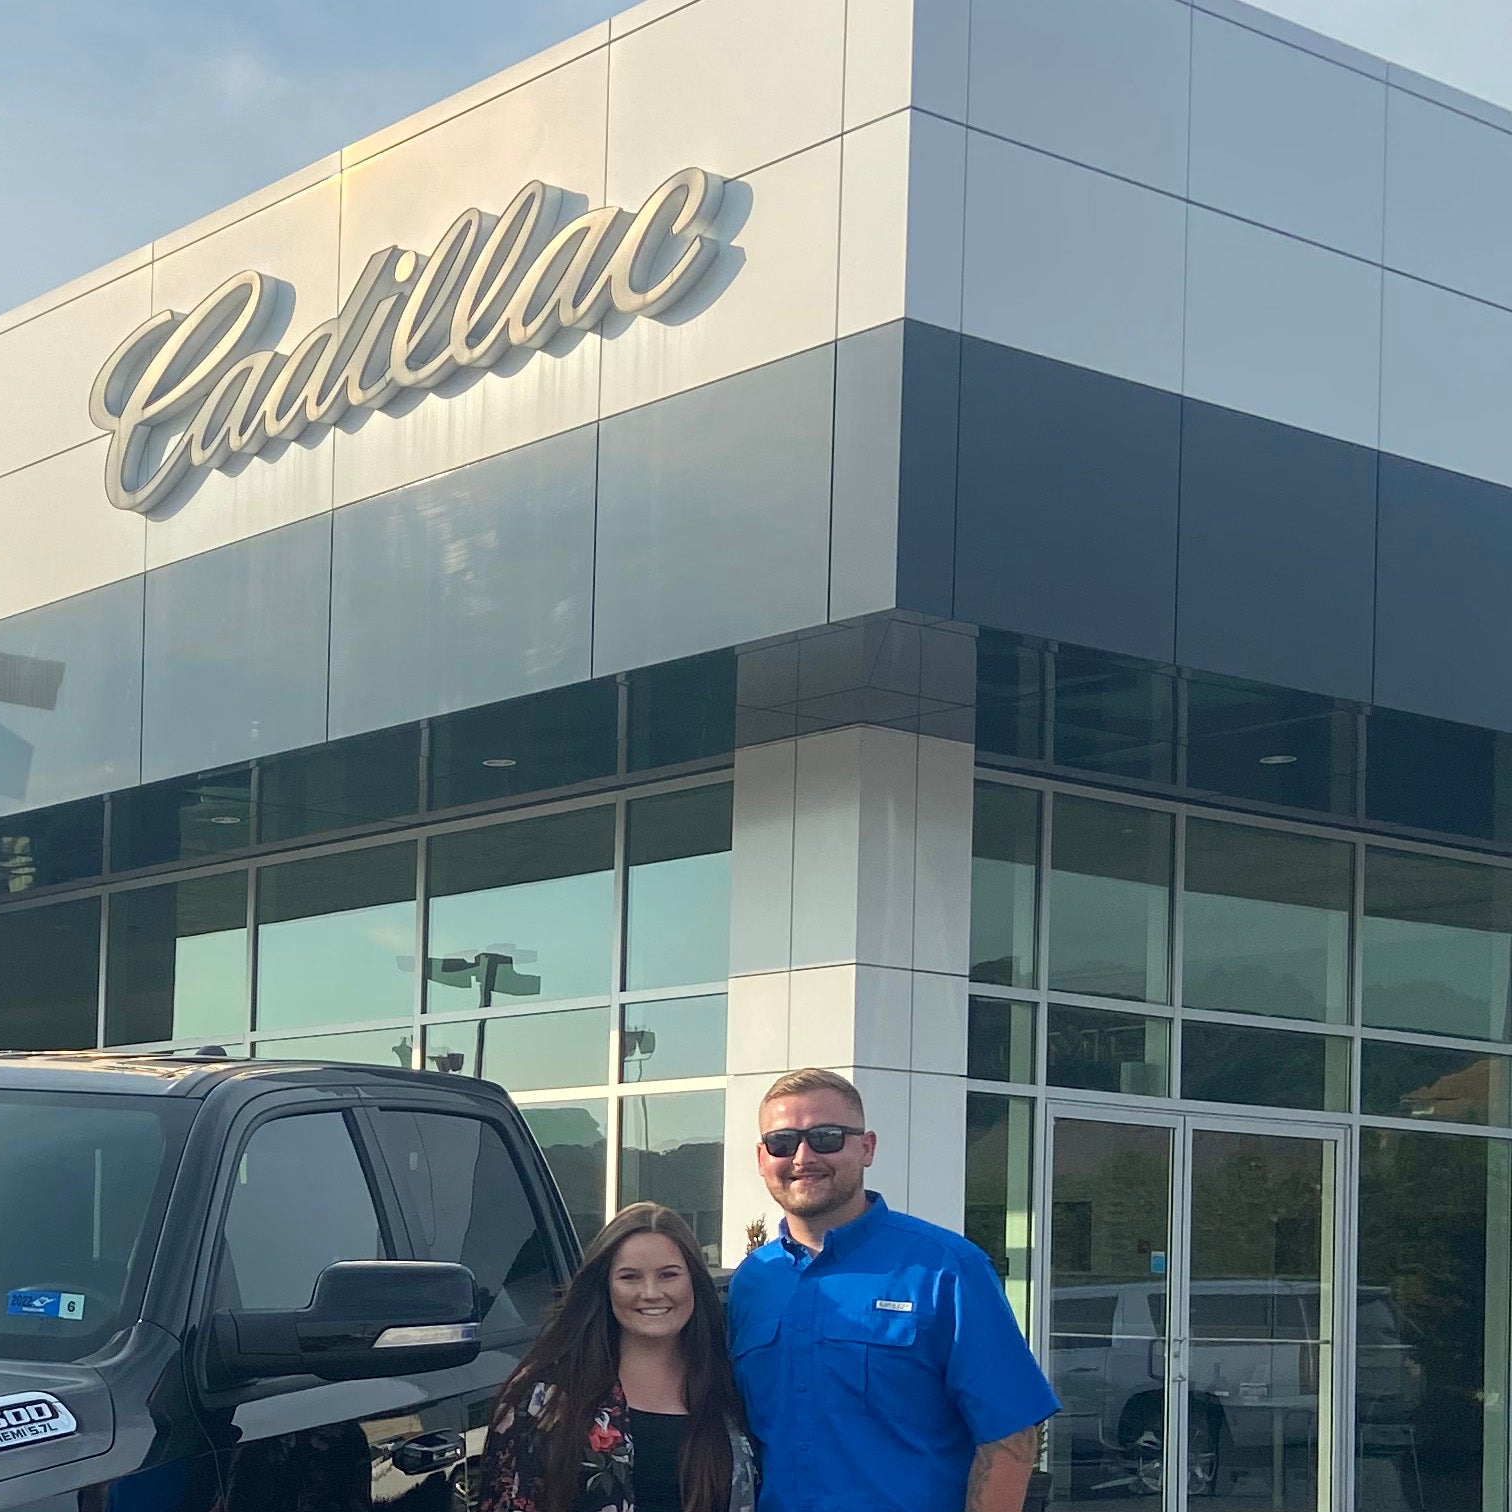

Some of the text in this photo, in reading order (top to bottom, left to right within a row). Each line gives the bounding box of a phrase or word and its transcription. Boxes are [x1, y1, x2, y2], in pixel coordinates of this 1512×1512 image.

[88, 166, 721, 514] Cadillac
[67, 1300, 76, 1313] 6
[29, 1422, 58, 1436] 5.7L
